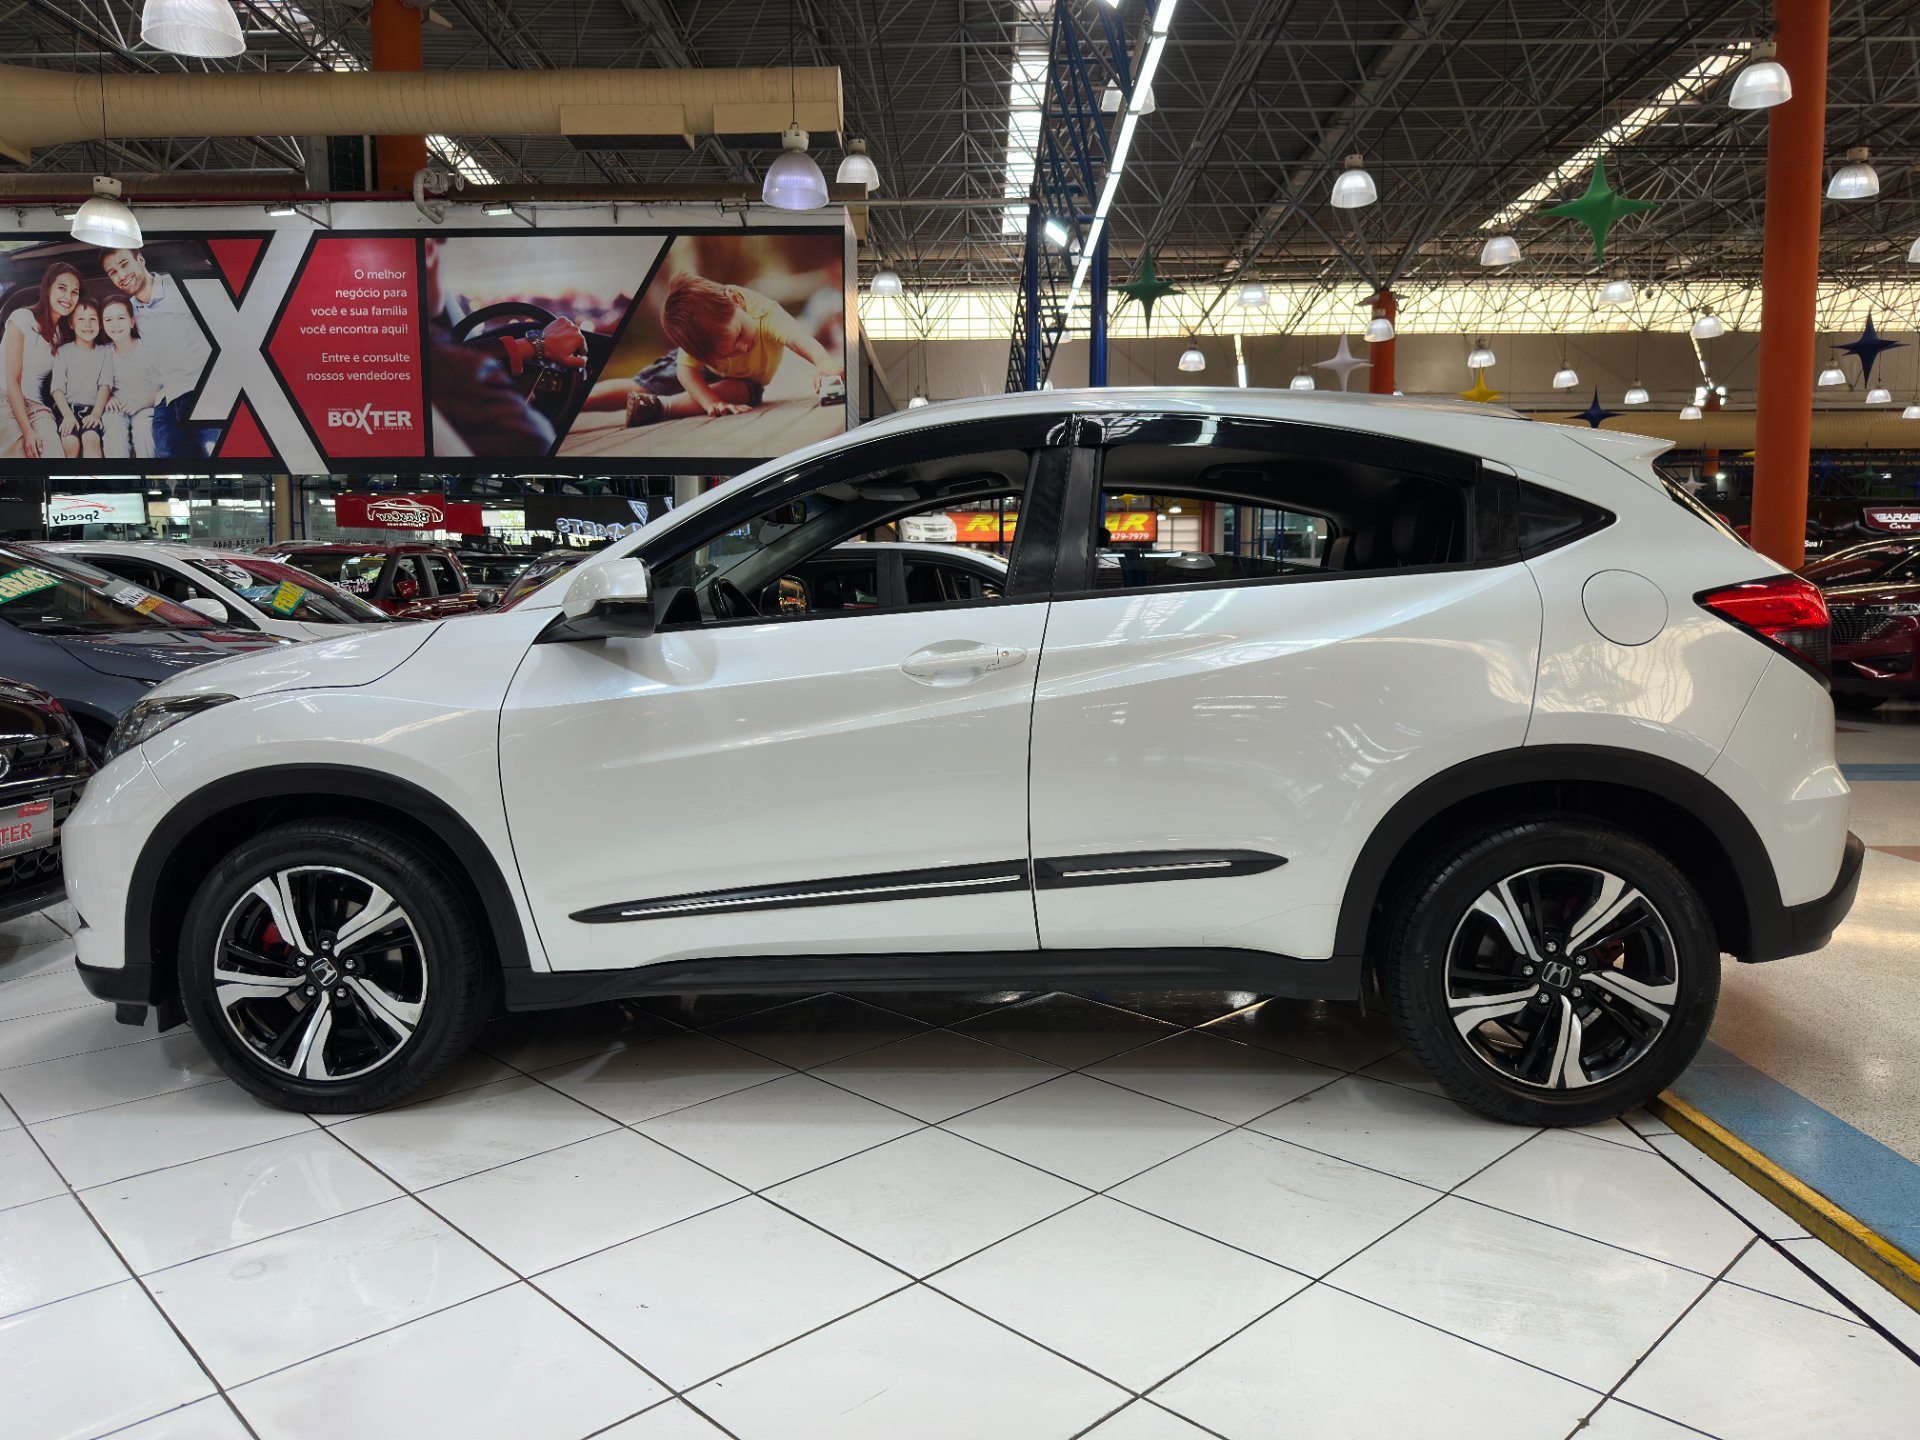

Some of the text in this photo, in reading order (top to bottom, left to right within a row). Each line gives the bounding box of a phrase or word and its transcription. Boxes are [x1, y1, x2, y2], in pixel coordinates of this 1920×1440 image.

[354, 269, 407, 280] O melhor
[335, 288, 408, 300] negócio para
[311, 306, 408, 316] você e sua família
[300, 324, 409, 336] você encontra aqui!
[322, 352, 410, 363] Entre e consulte
[307, 370, 411, 381] nossos vendedores
[328, 402, 413, 435] BOXTER
